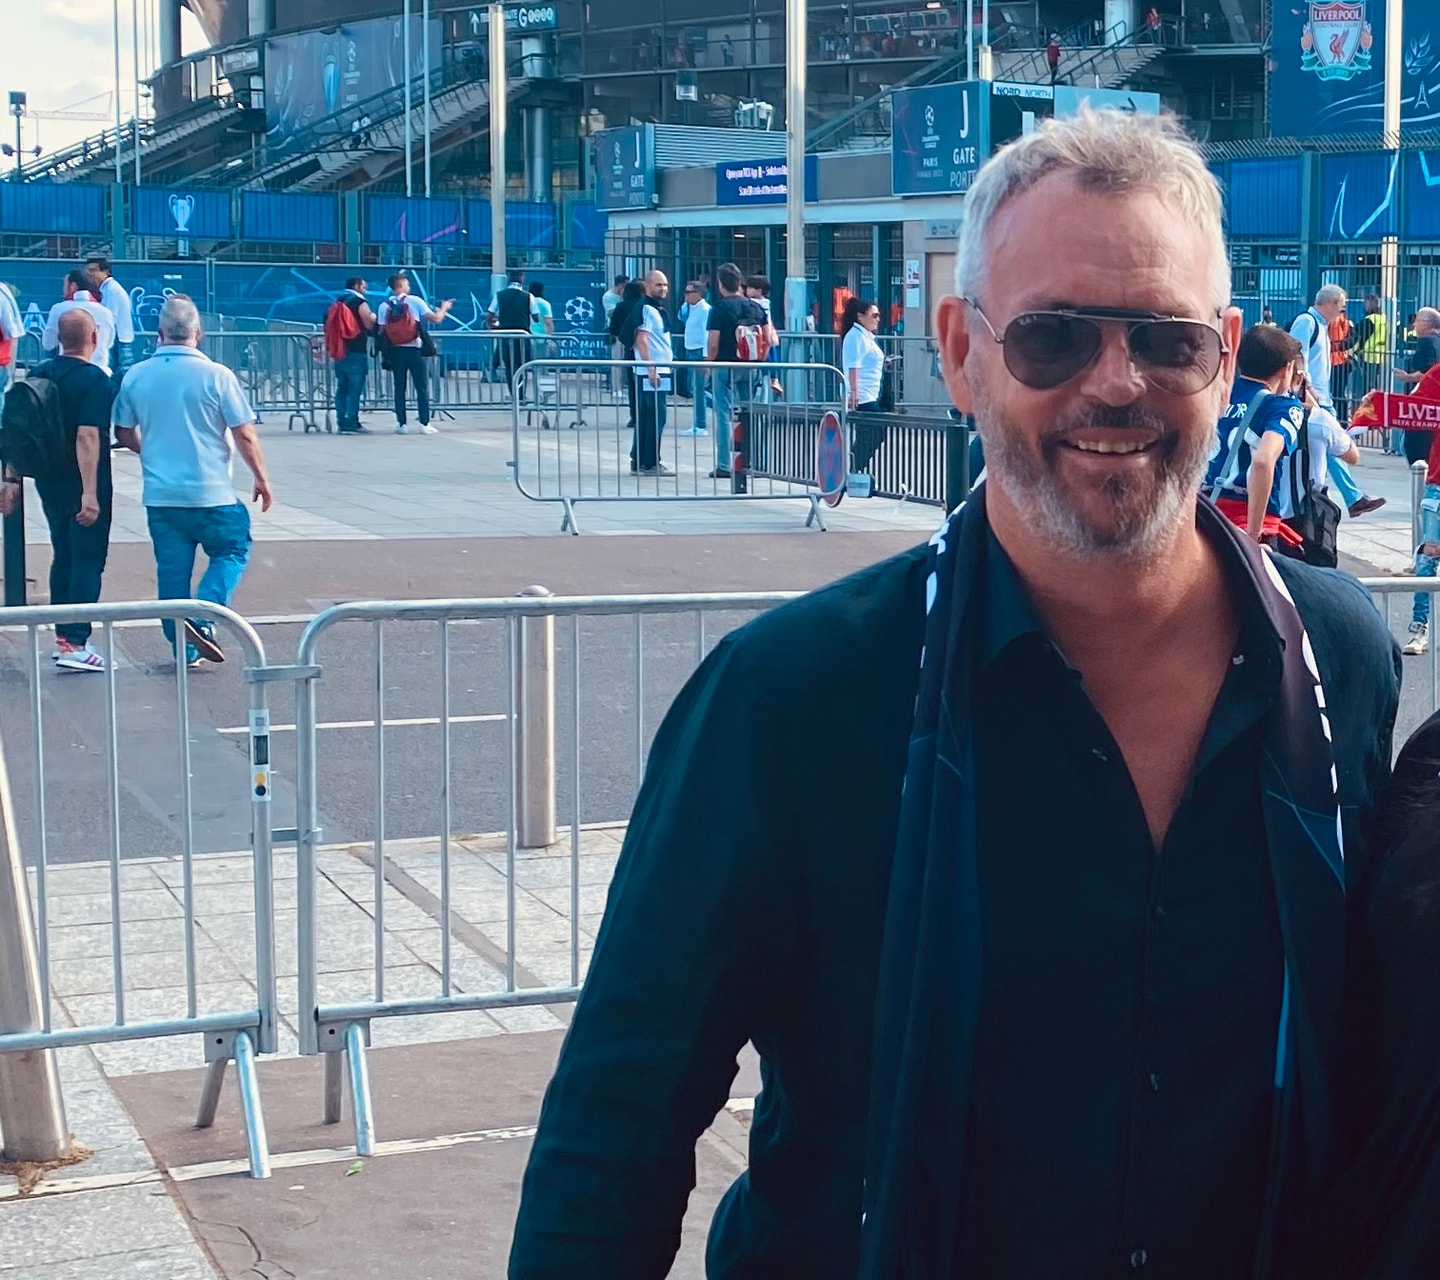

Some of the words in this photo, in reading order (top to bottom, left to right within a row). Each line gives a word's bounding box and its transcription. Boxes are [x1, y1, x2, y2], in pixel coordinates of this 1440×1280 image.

[1315, 10, 1360, 21] LIVERPOOL
[996, 86, 1021, 97] NORD
[960, 90, 969, 138] J
[953, 147, 975, 164] GATE
[630, 174, 644, 187] GATE
